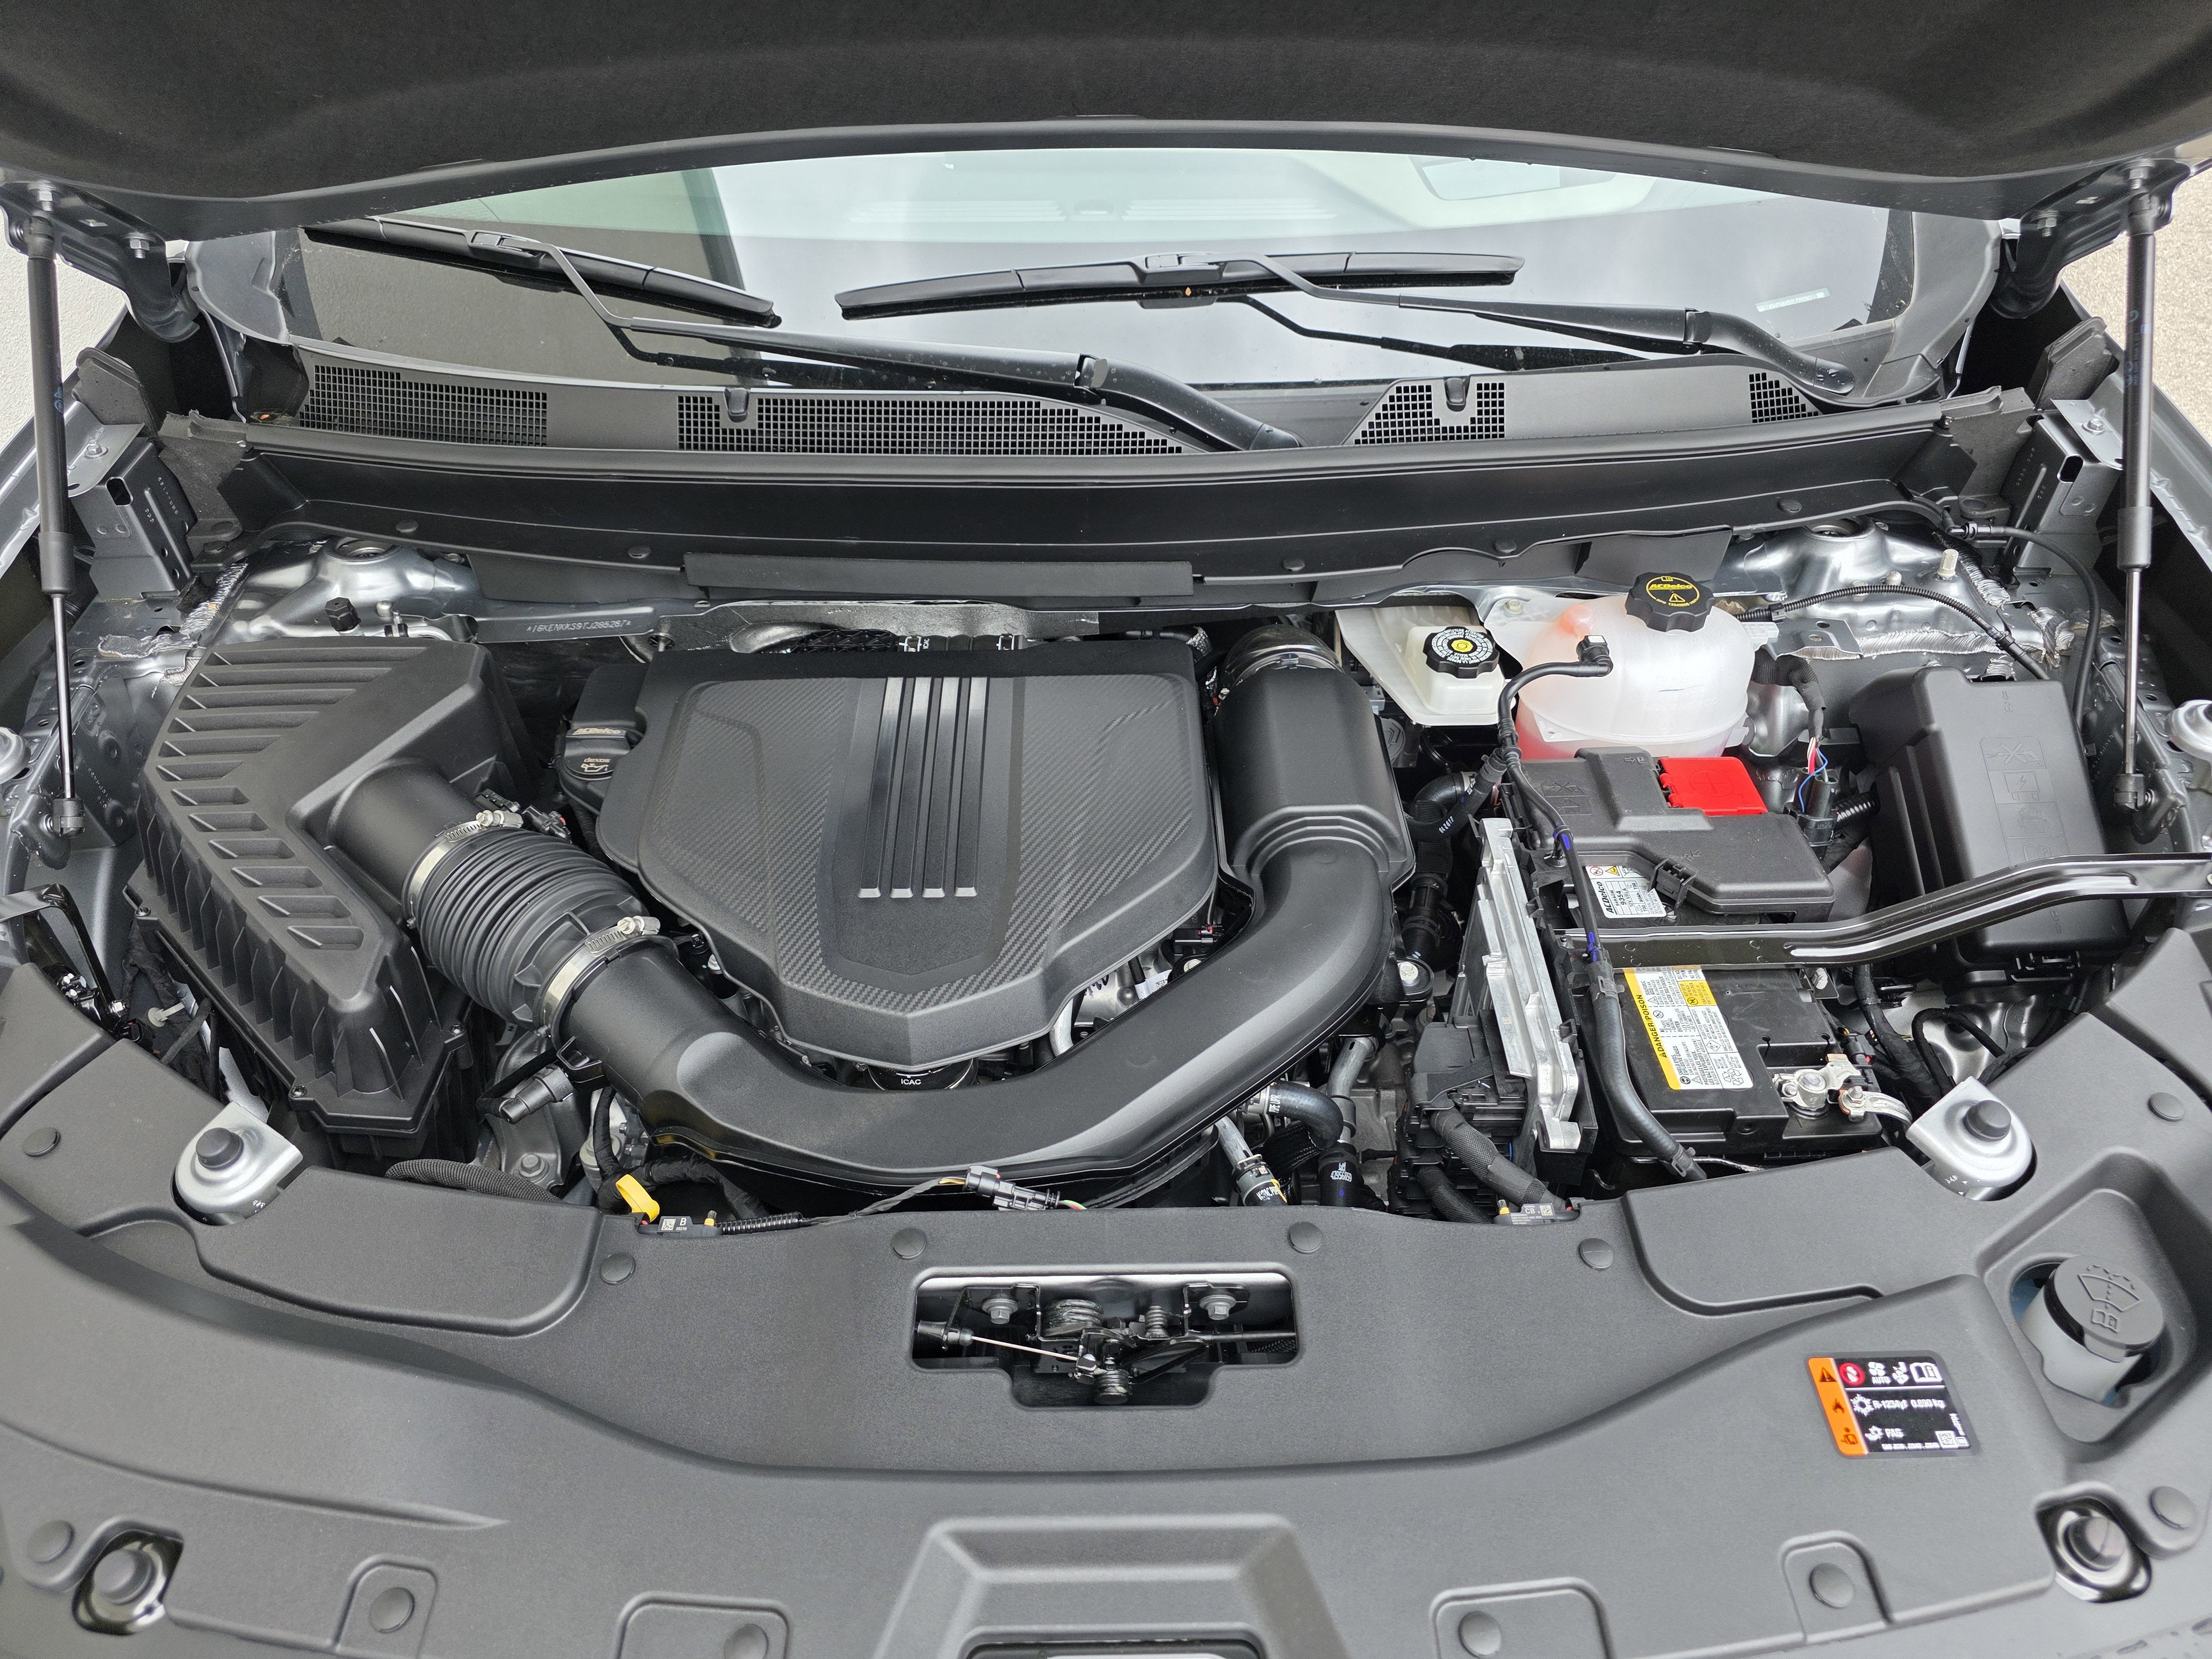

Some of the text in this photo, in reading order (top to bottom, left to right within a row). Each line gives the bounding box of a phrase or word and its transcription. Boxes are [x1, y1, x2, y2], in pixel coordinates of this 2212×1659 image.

[1594, 881, 1614, 914] ACDelco
[1609, 890, 1619, 906] 94RAGM
[1615, 890, 1626, 905] 9354
[1635, 994, 1664, 1051] DANGER/POISON
[1691, 1039, 1700, 1052] PEUVENT
[1672, 1046, 1689, 1075] EXPLOSIVE GASES
[1697, 1052, 1708, 1070] EXPLOSIFS
[1674, 1063, 1683, 1075] SHIELD
[1270, 1094, 1281, 1104] UPR
[1871, 1376, 1891, 1385] AUTO
[1872, 1399, 1946, 1410] R-1234yf 0.890 kg
[1885, 1428, 1905, 1438] PAG
